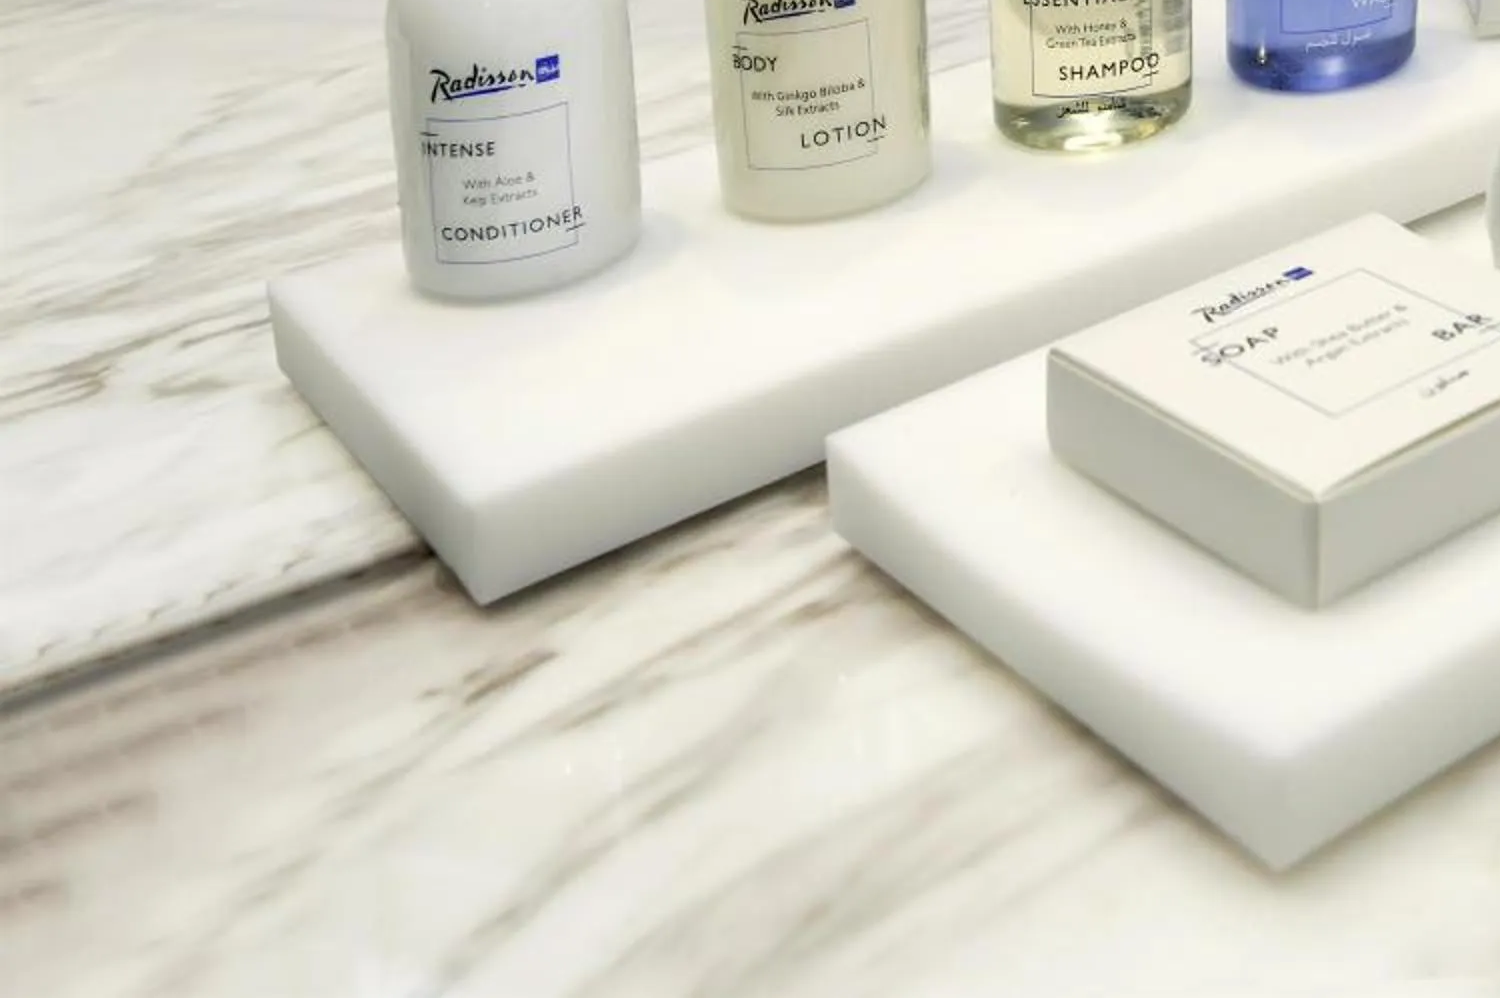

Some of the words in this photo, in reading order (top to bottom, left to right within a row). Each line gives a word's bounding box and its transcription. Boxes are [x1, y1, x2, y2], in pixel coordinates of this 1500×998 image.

[1055, 22, 1081, 35] With
[732, 53, 778, 72] BODY
[1058, 52, 1160, 82] SHAMPOO
[429, 62, 535, 104] Radisson
[857, 77, 865, 89] &
[800, 114, 888, 149] LOTION
[420, 140, 497, 159] INTENSE
[440, 205, 583, 242] CONDITIONER
[1190, 280, 1290, 322] Radisson
[1431, 312, 1493, 343] BAR
[1201, 325, 1279, 367] SOAP
